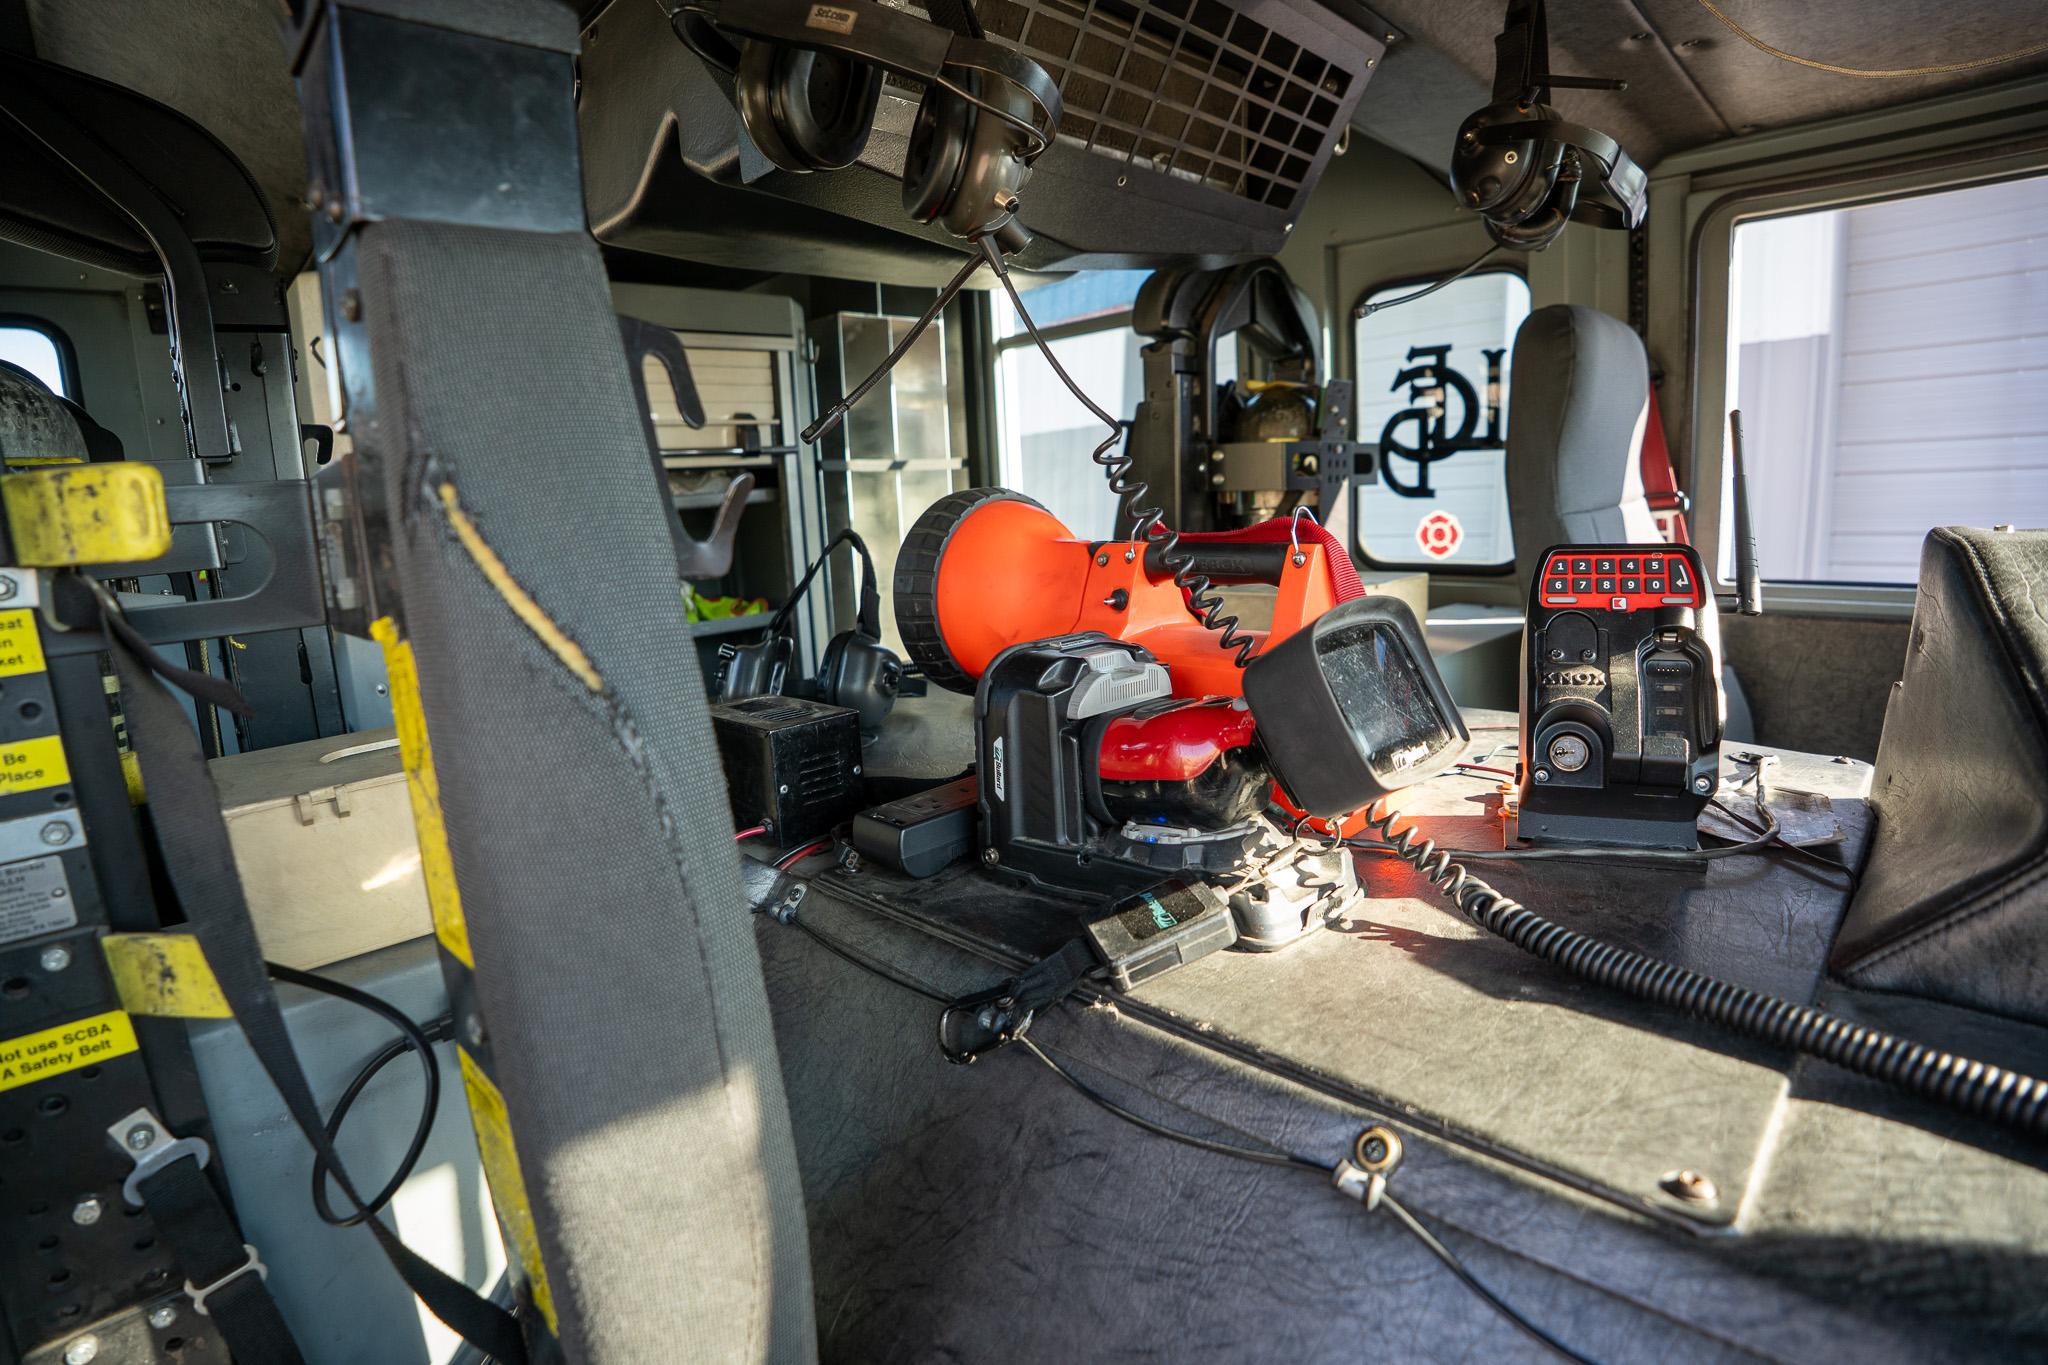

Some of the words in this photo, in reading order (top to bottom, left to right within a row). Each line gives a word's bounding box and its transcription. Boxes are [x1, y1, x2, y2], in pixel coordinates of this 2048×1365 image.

[1557, 562, 1564, 571] 1
[1579, 562, 1586, 570] 2
[1602, 562, 1610, 570] 3
[1626, 561, 1635, 570] 4
[1651, 561, 1659, 570] 5
[1555, 581, 1562, 589] 6
[1579, 581, 1587, 589] 7
[1603, 581, 1610, 589] 8
[1627, 581, 1635, 589] 9
[1652, 580, 1660, 589] 0
[1541, 671, 1607, 685] KNOX
[3, 753, 27, 767] Be
[26, 1040, 58, 1056] use
[62, 1023, 112, 1045] SCBA
[3, 1068, 16, 1080] A
[20, 1051, 74, 1075] Safety
[78, 1040, 112, 1057] Belt
